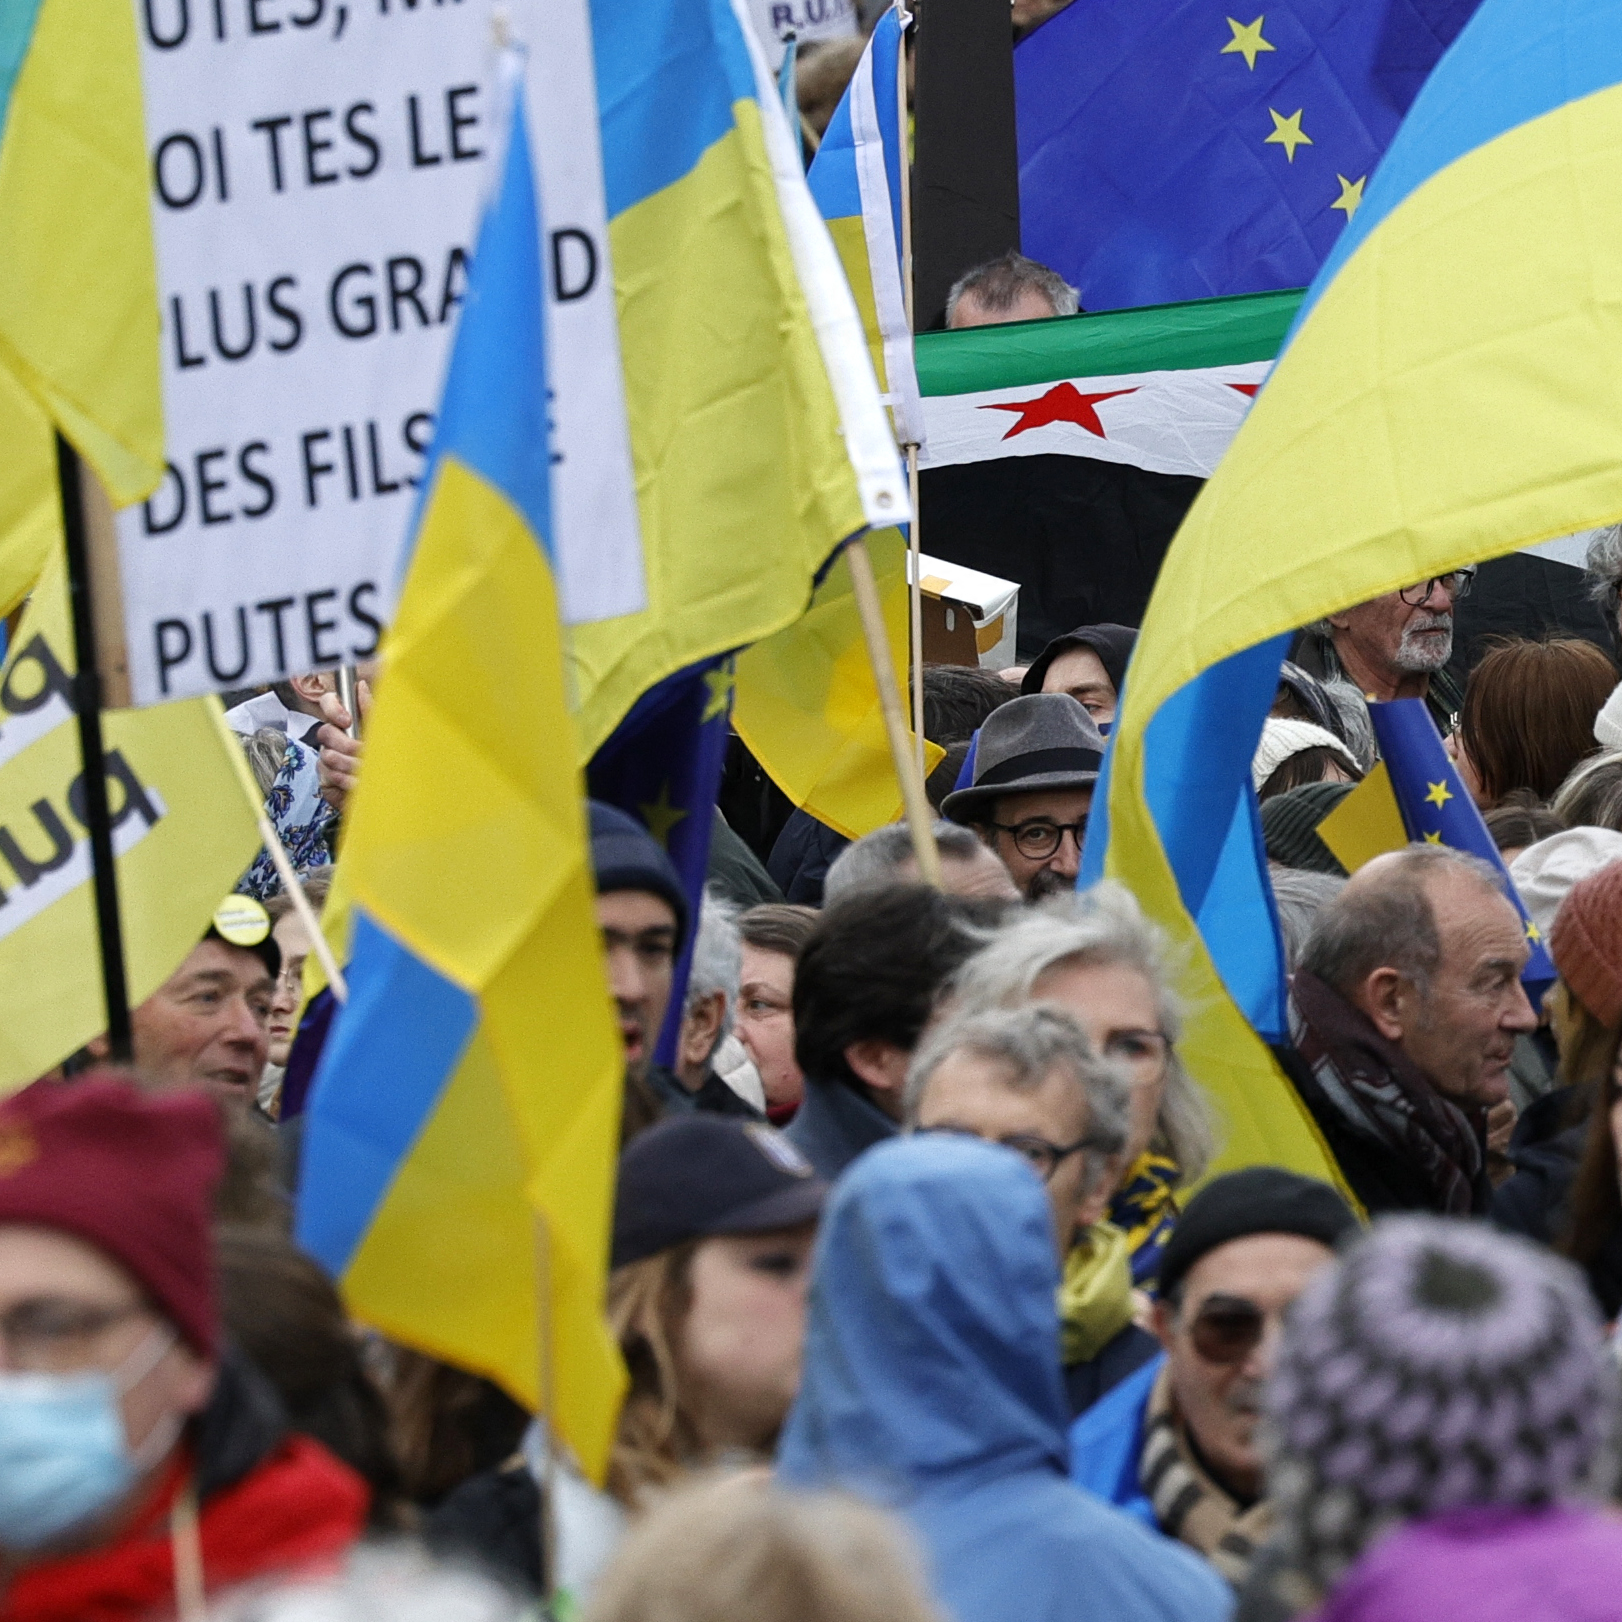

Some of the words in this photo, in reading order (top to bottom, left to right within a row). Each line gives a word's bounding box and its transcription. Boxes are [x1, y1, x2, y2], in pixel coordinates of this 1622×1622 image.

[152, 126, 233, 212] OI
[253, 101, 385, 194] TES
[407, 83, 487, 169] LE
[168, 274, 305, 372] LUS
[329, 225, 602, 340] GRAD
[142, 439, 277, 540] DES
[152, 581, 388, 698] PUTES
